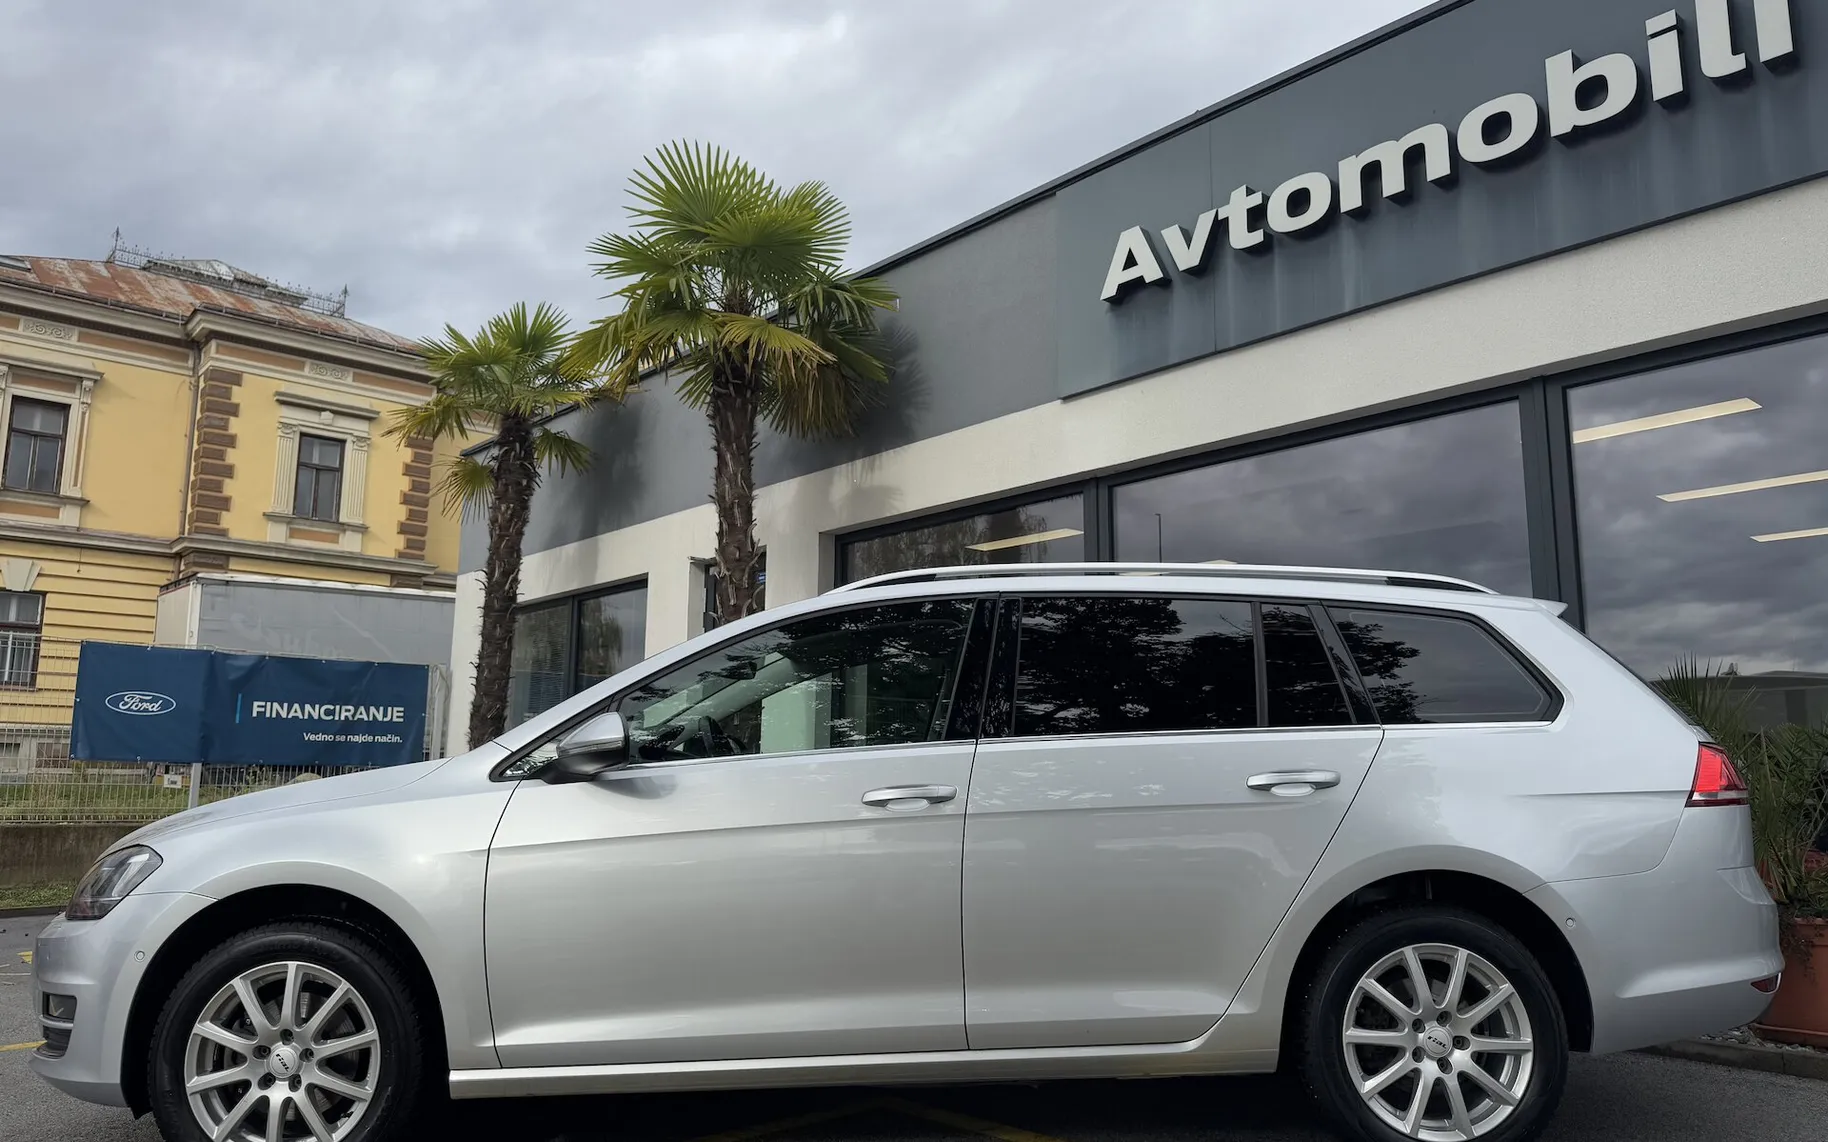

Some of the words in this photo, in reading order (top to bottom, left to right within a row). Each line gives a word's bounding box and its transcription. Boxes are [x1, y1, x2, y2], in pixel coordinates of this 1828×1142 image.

[119, 694, 163, 711] Ford
[252, 701, 404, 722] FINANCIRANJE
[303, 732, 334, 742] Vedno
[335, 734, 346, 742] se
[347, 733, 373, 743] najde
[375, 733, 403, 743] način.
